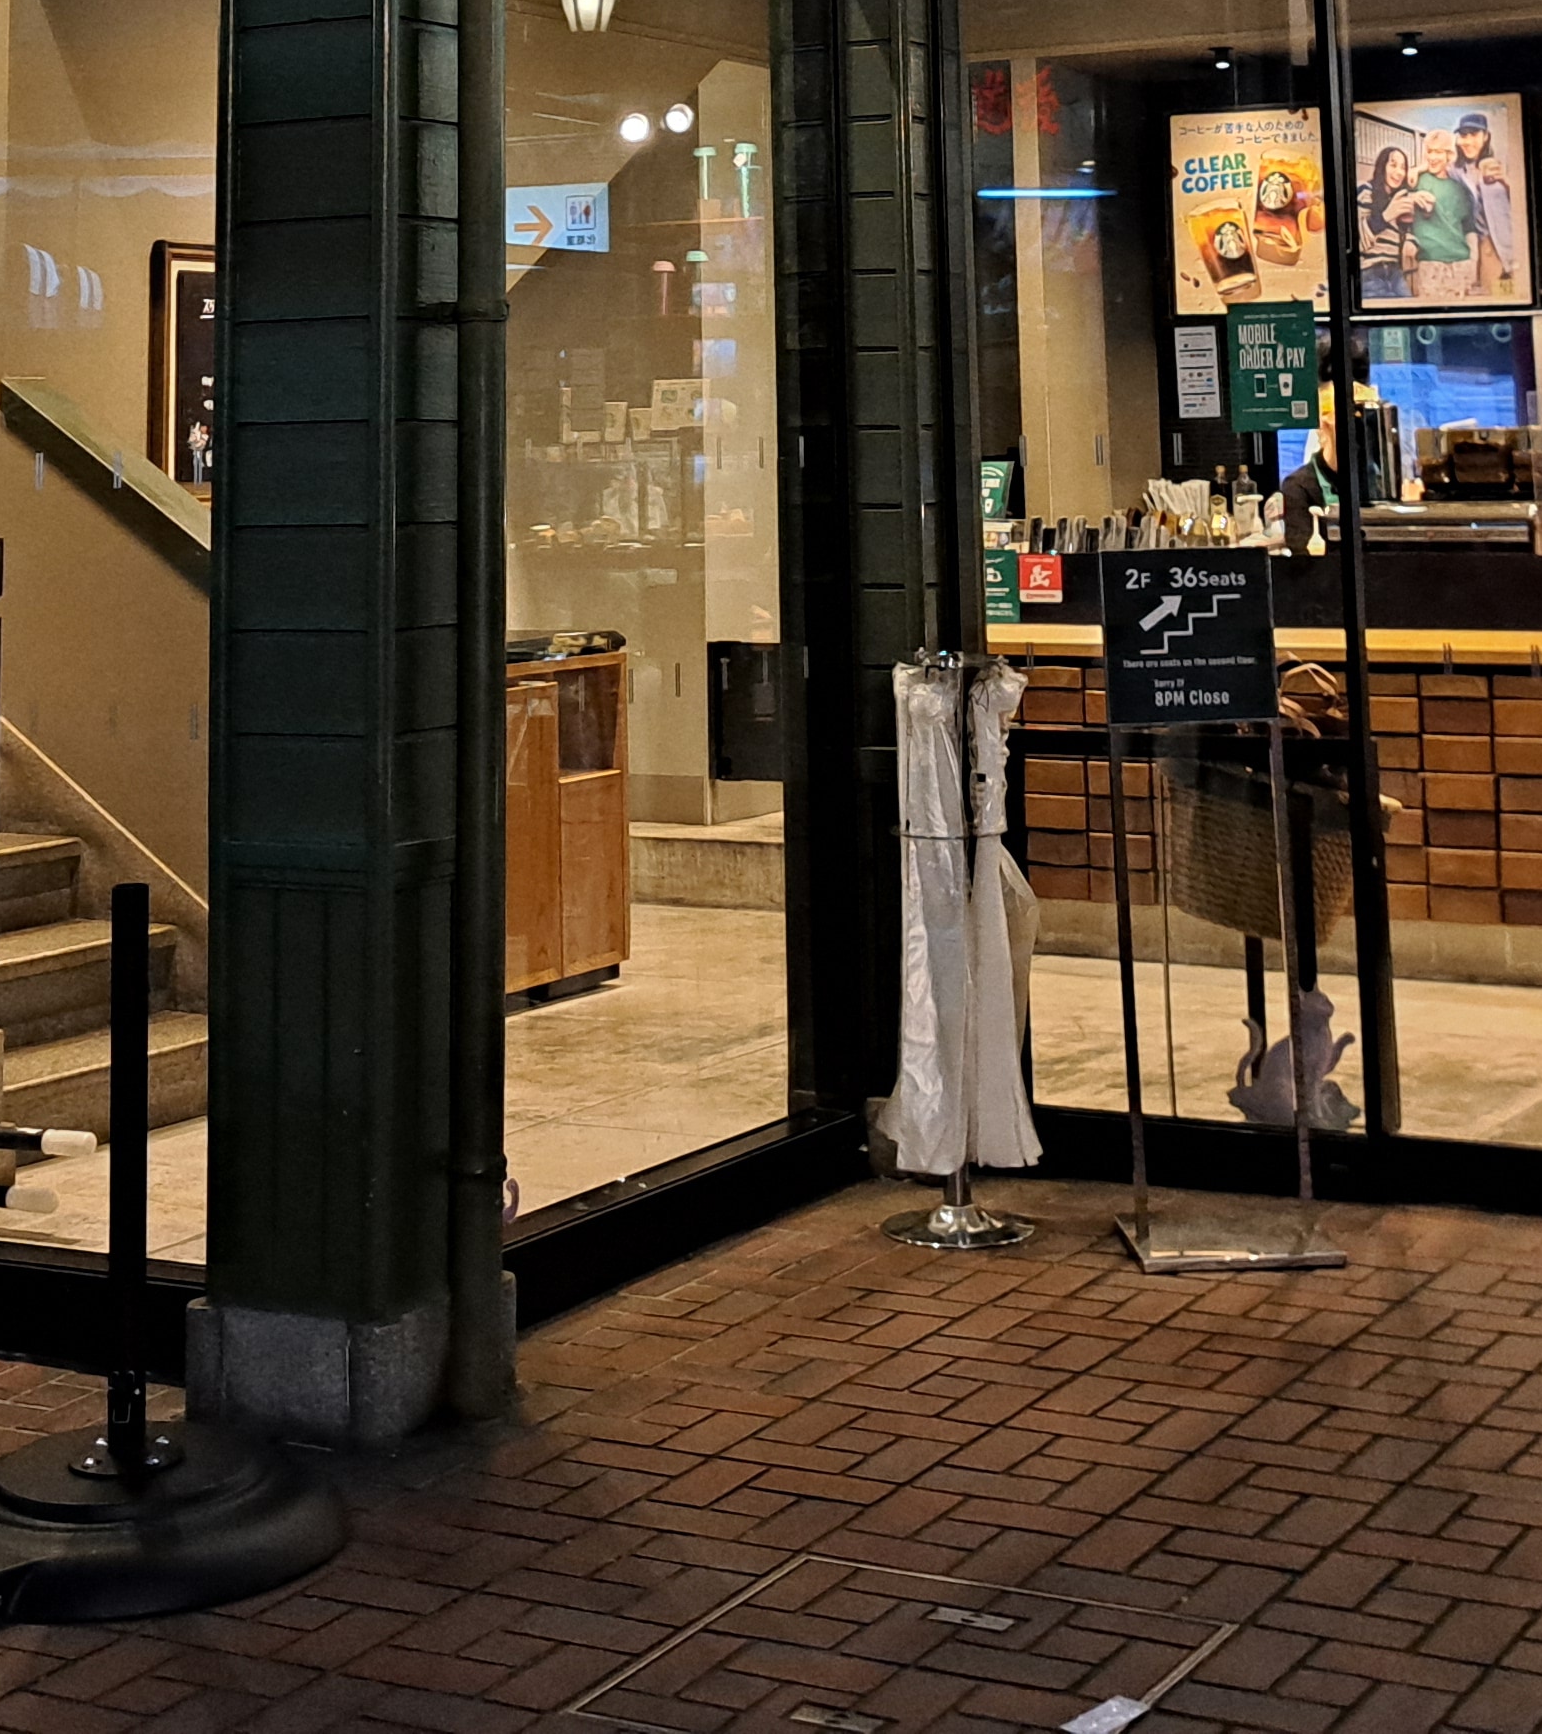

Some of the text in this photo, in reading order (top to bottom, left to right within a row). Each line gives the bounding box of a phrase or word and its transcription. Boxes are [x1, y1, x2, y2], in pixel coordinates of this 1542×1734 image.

[1179, 119, 1304, 136] コーヒーが苦手な人のための
[1184, 152, 1247, 175] CLEAR
[1181, 170, 1253, 194] COFFEE
[1237, 323, 1277, 345] MOBILE
[1239, 343, 1306, 370] ORDER & PAY
[1125, 567, 1247, 590] 2F 36Seats
[1154, 689, 1230, 707] 8PM Close
